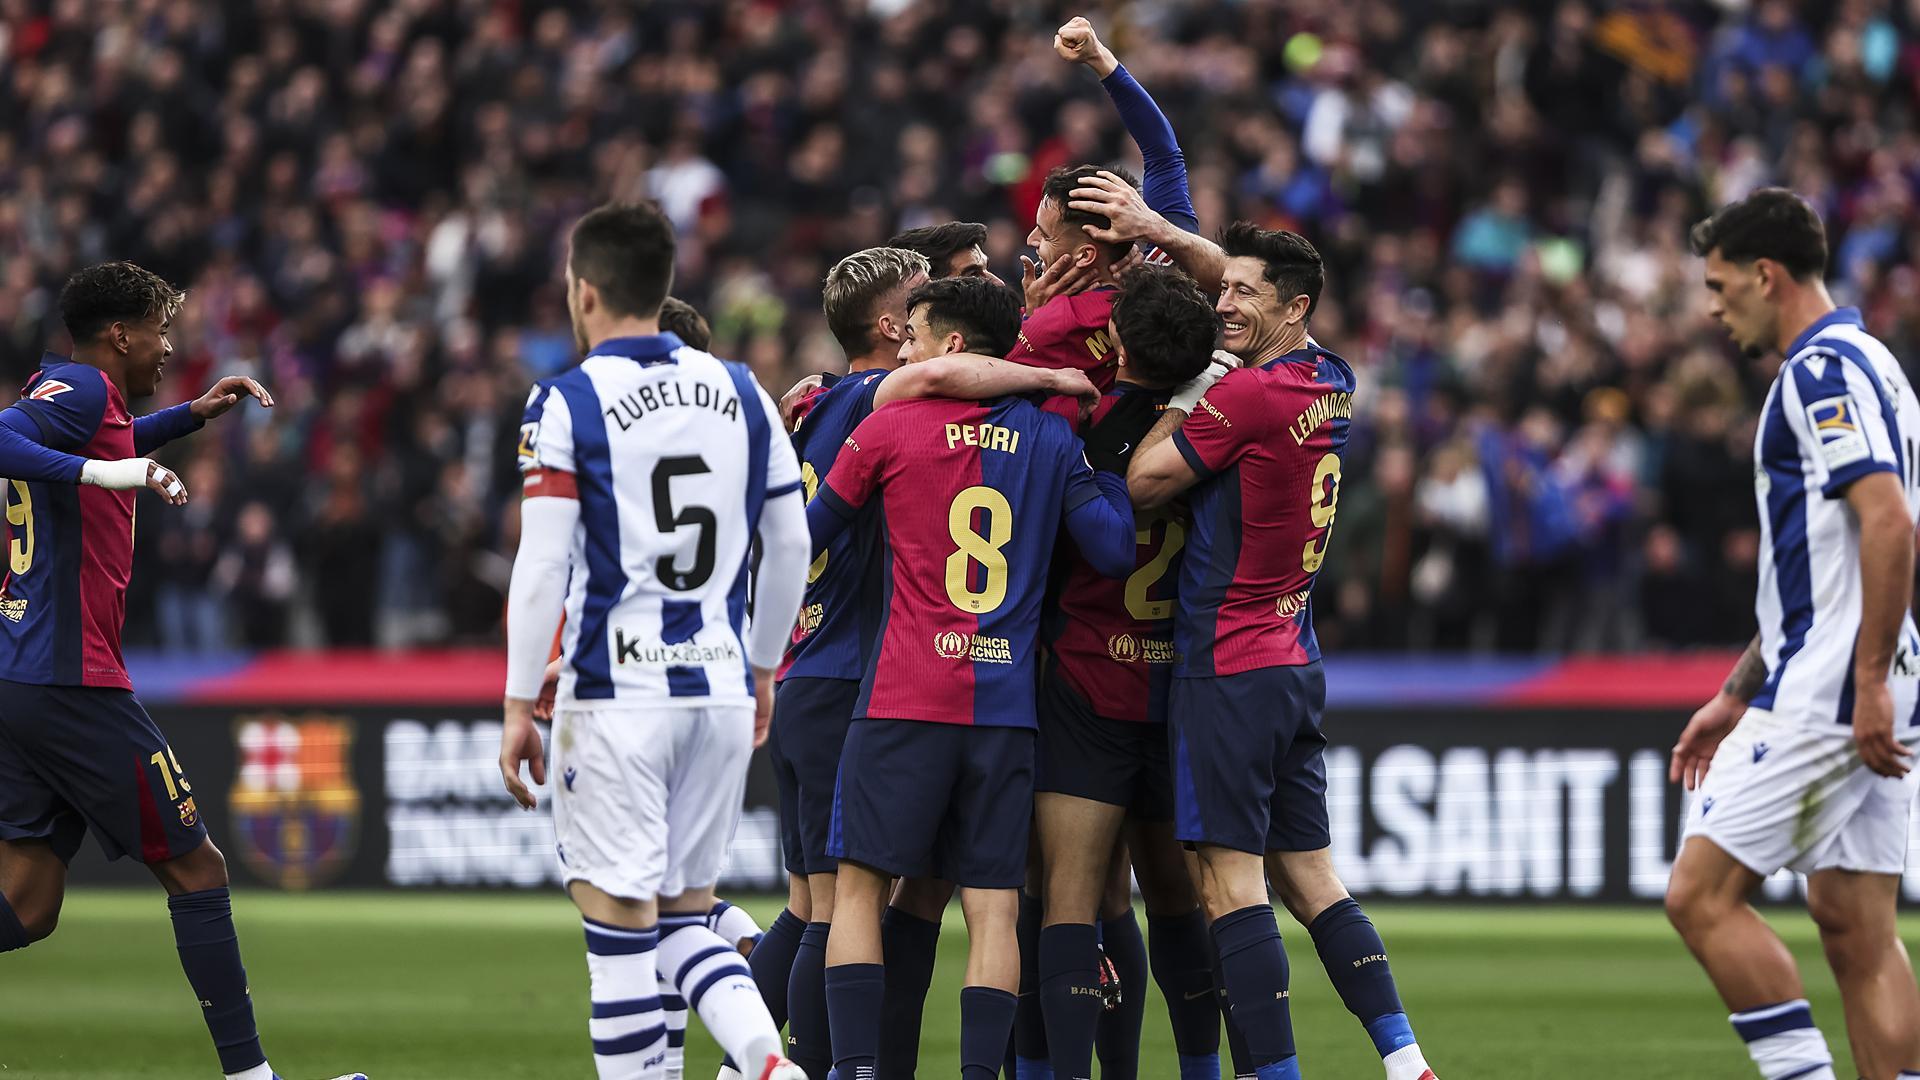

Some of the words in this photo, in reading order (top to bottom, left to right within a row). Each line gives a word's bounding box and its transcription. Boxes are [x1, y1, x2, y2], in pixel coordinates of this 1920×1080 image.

[606, 380, 739, 432] ZUBELDIA
[945, 423, 1020, 455] PEDRI
[651, 454, 716, 592] 5
[944, 485, 1013, 615] 8
[1302, 453, 1342, 573] 9
[969, 646, 1012, 660] ACNUR
[971, 634, 1010, 650] UNHCR
[1325, 742, 1622, 899] LSANT
